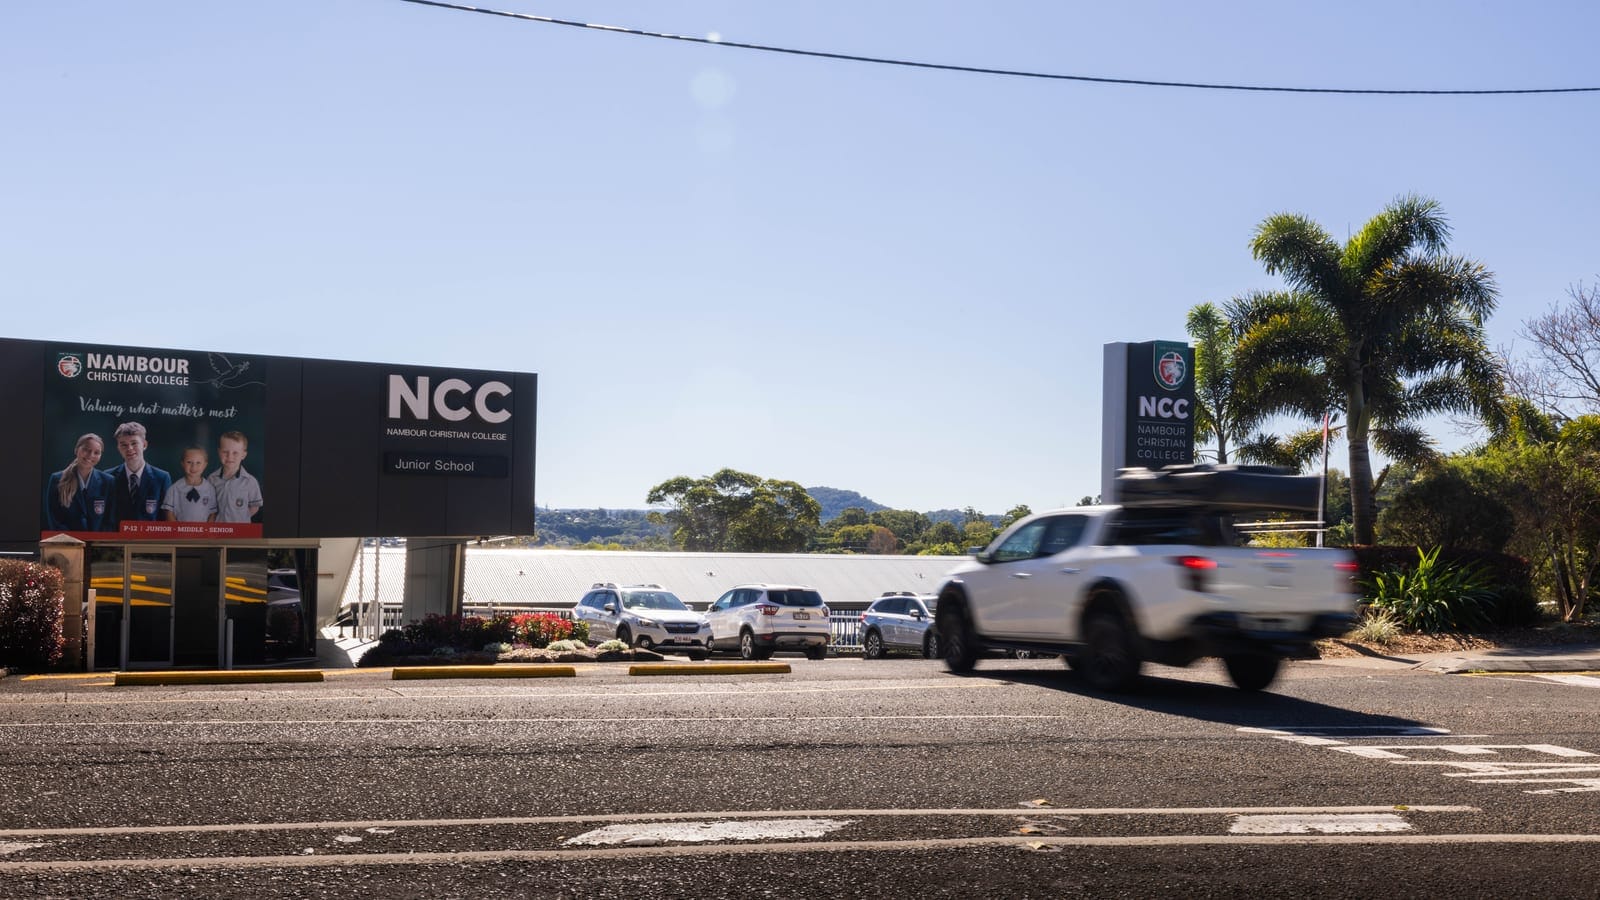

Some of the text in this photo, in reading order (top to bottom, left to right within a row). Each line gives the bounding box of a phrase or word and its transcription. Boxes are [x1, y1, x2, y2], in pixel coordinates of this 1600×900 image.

[86, 353, 189, 374] NAMBOUR
[86, 371, 189, 386] CHRISTIAN COLLEGE
[388, 374, 512, 423] NCC
[79, 396, 238, 418] Valuing what matters most
[1139, 396, 1189, 419] NCC
[386, 428, 507, 441] NAMBOUR CHRISTIAN COLLEGE
[1137, 425, 1186, 436] NAMBOUR
[1137, 437, 1186, 448] CHRISTIAN
[1137, 449, 1185, 460] COLLEGE
[395, 459, 475, 472] Junior School
